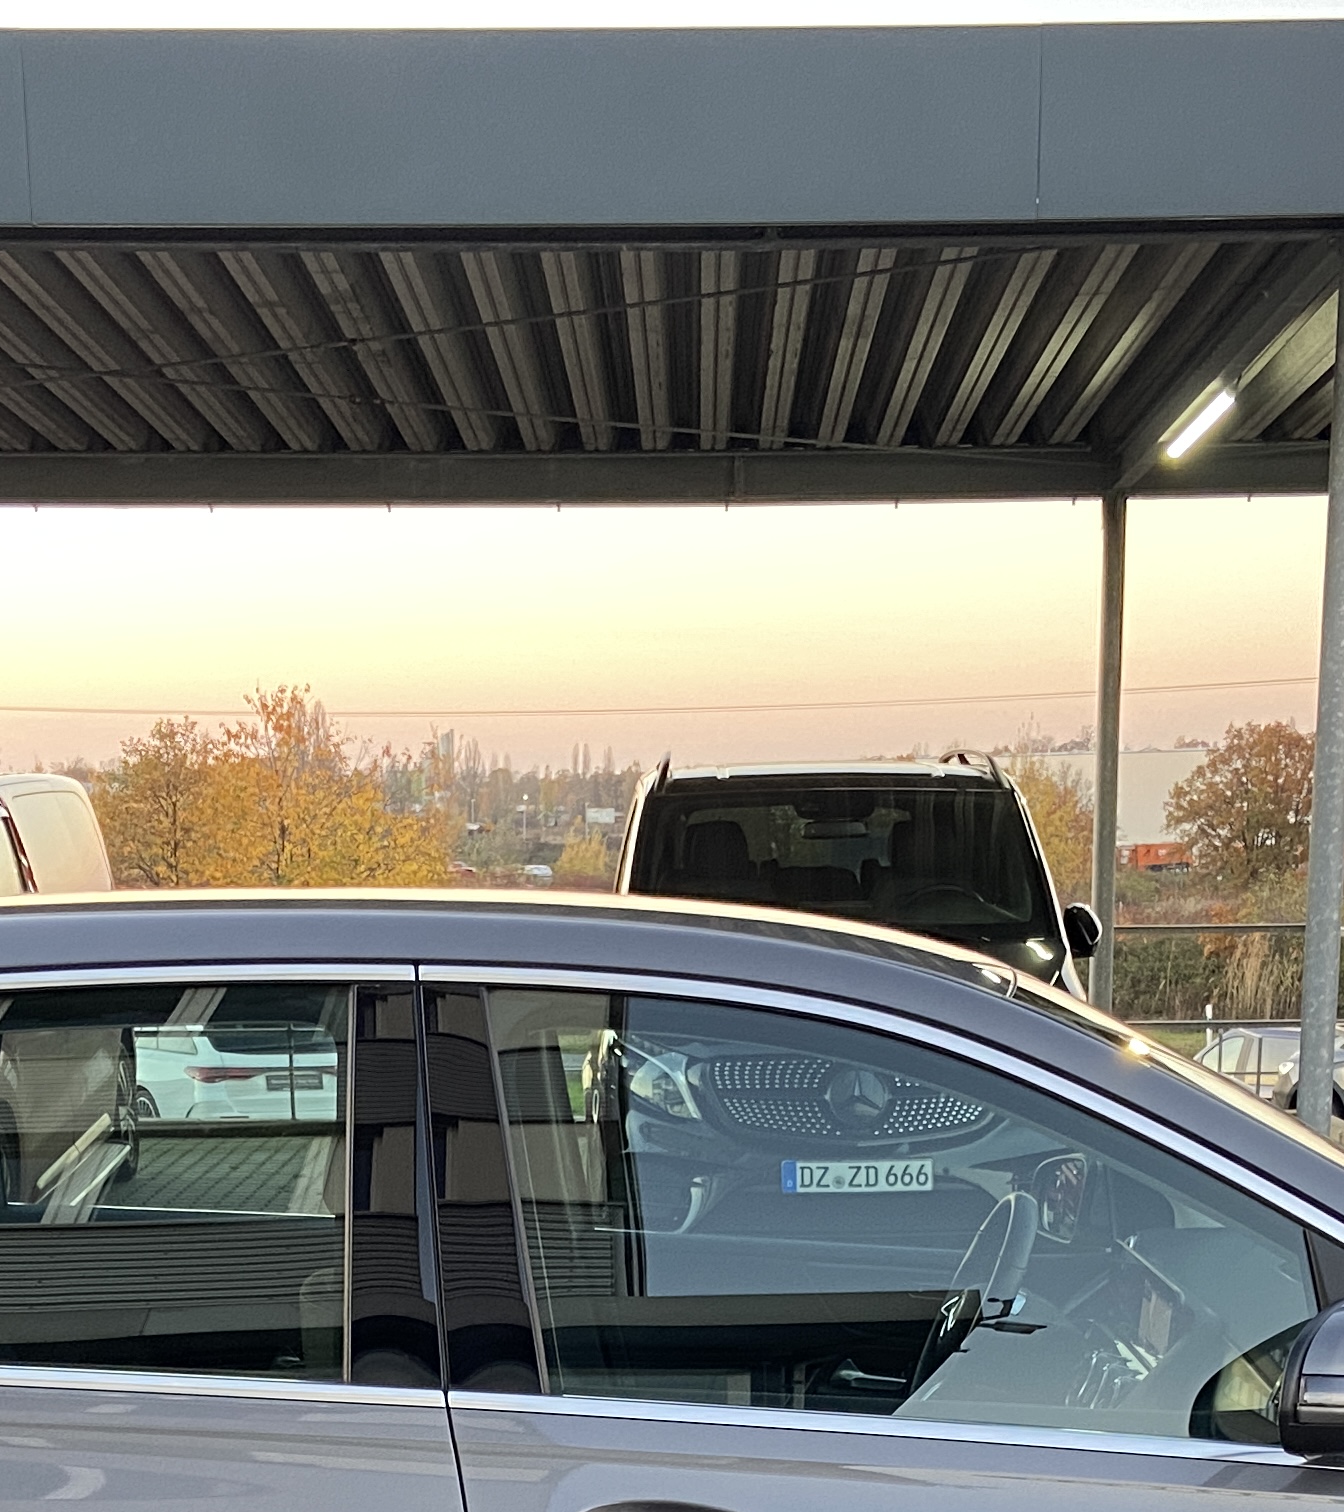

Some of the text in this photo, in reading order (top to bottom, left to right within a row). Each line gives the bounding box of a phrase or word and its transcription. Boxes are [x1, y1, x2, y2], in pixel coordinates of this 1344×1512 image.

[799, 1164, 929, 1188] DZ ZD 666
